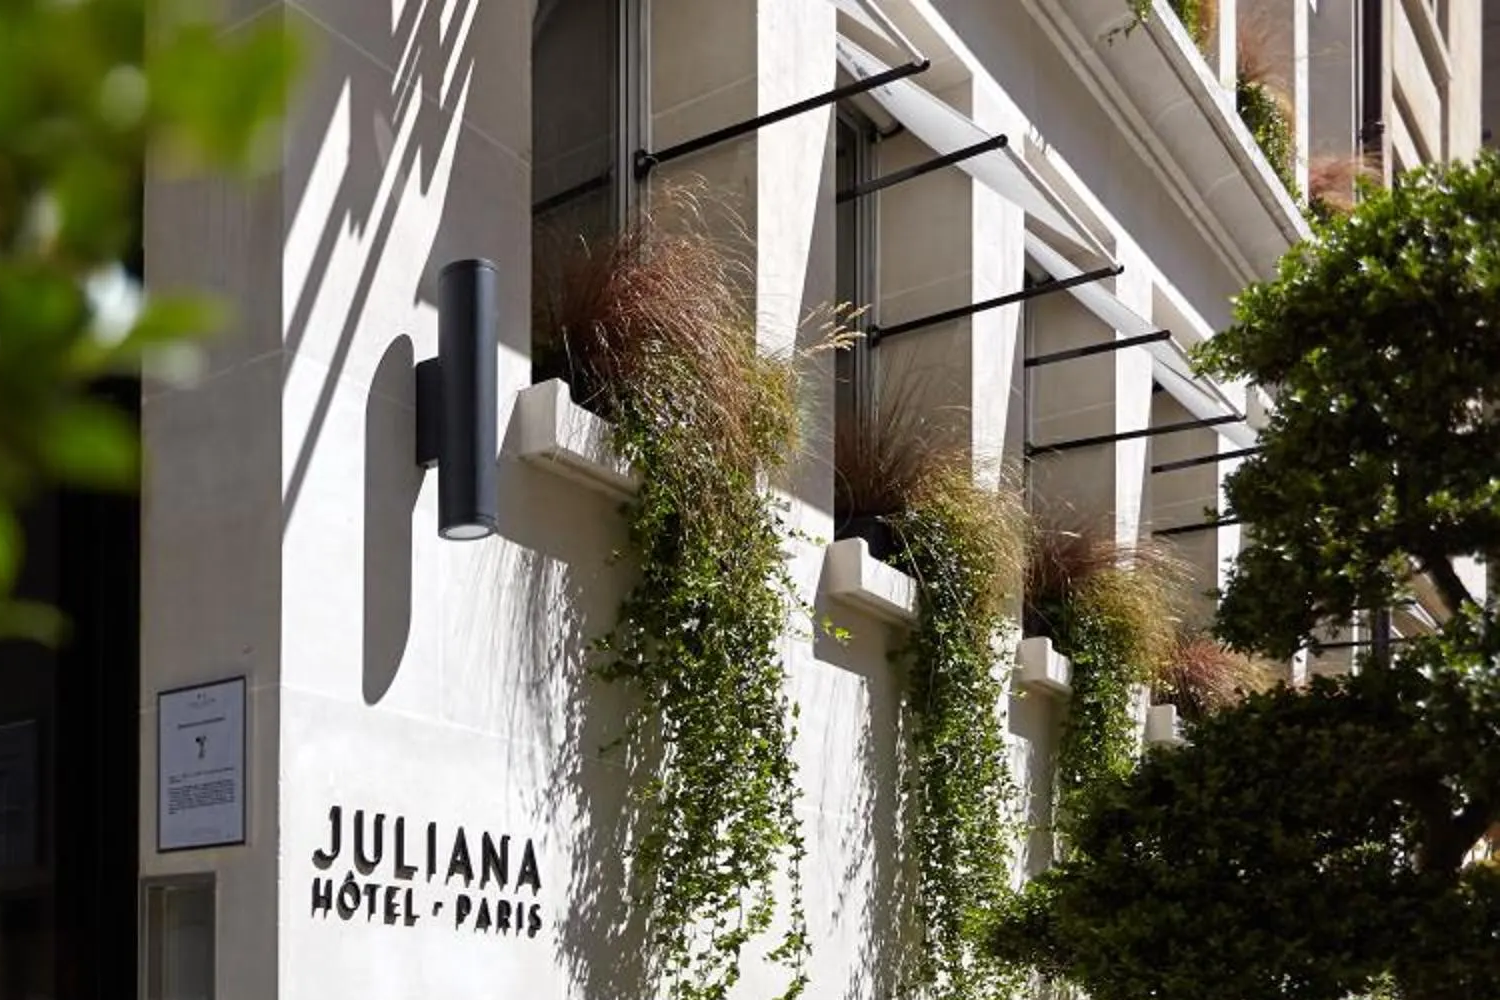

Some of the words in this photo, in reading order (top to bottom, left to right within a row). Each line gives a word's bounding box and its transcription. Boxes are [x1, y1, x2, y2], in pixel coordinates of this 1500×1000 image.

[311, 805, 542, 897] JULIANA
[311, 869, 421, 927] HÔTEL
[455, 894, 542, 938] PARIS
